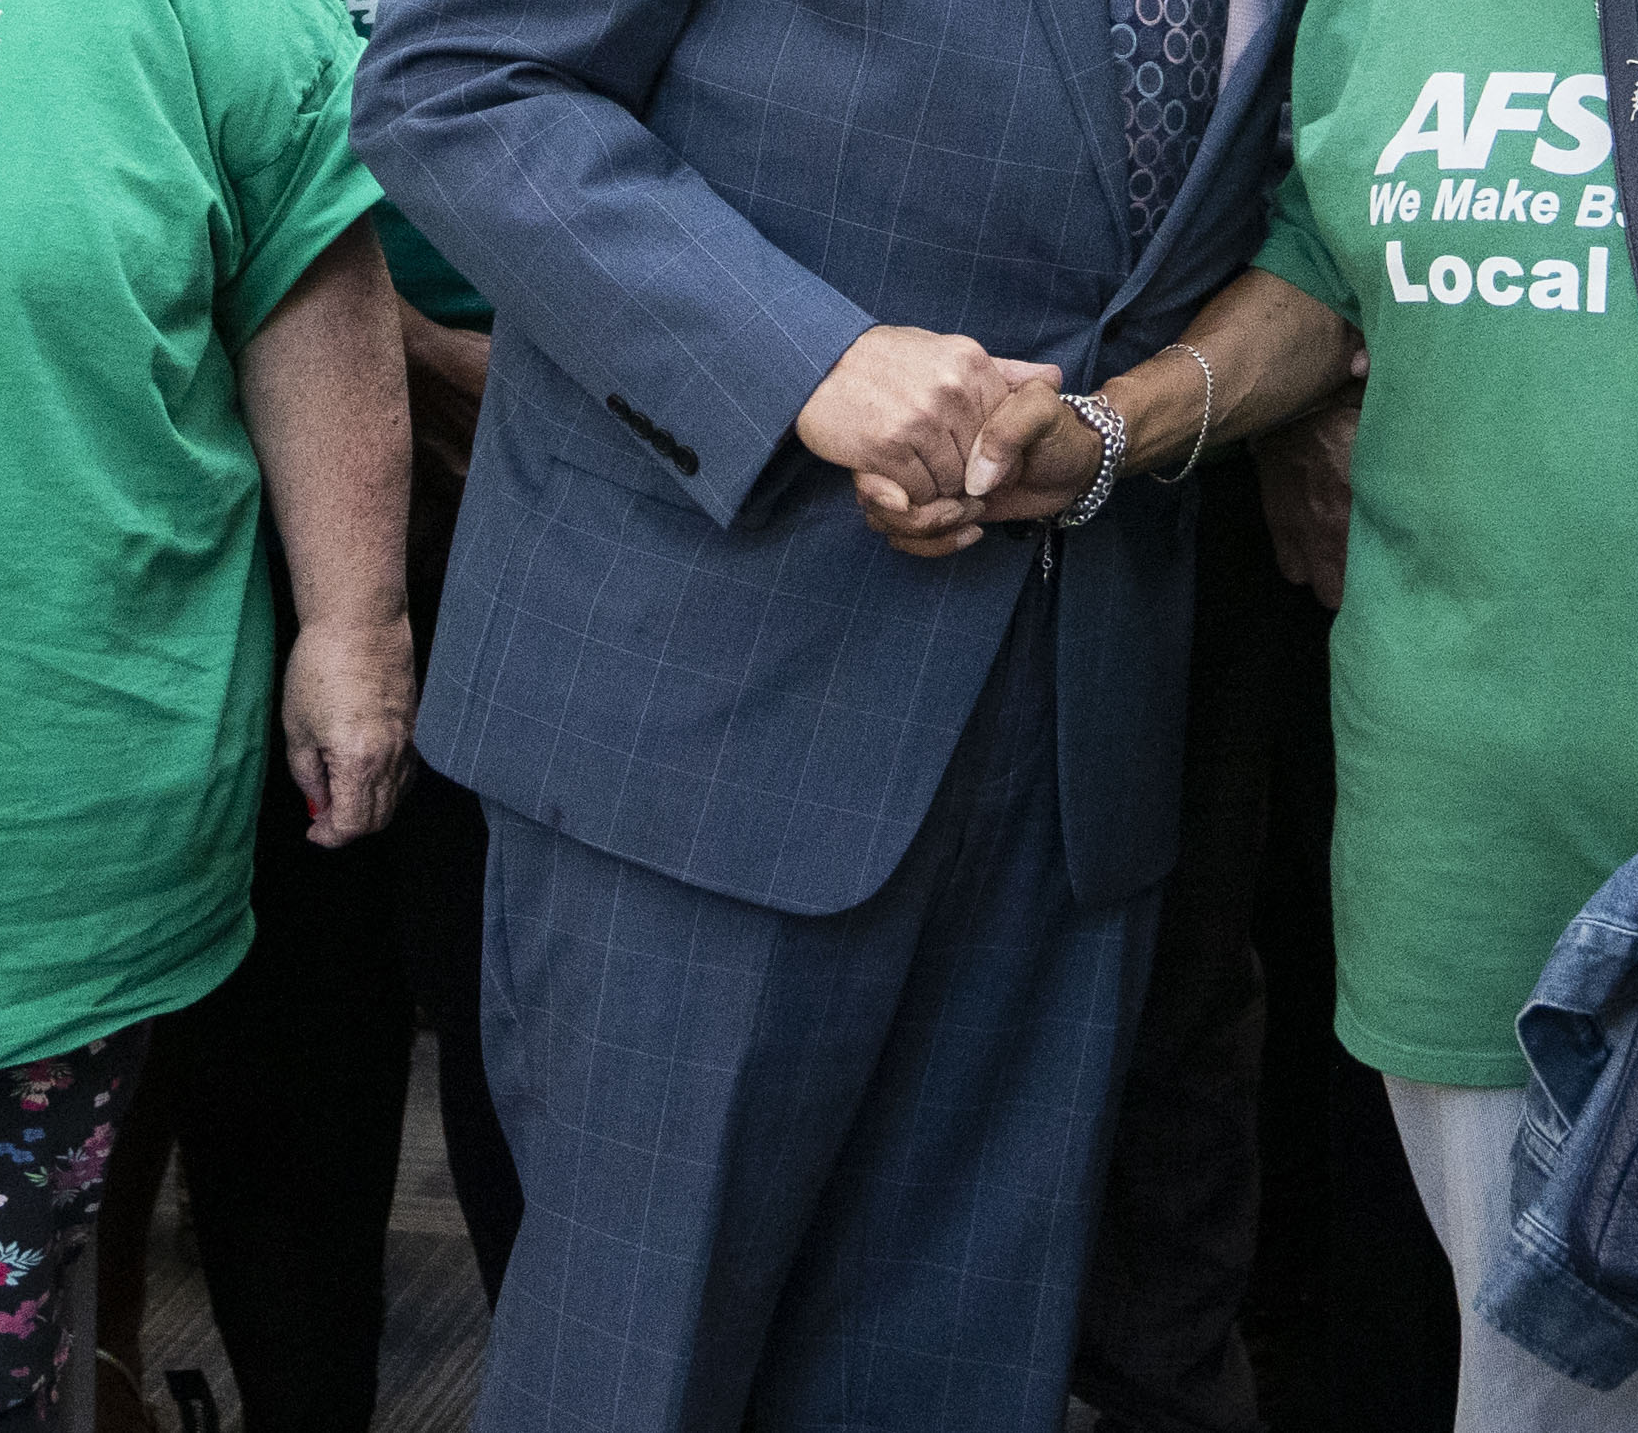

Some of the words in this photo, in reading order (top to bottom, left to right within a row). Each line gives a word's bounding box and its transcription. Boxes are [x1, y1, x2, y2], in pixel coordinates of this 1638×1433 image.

[1369, 181, 1420, 225] We
[1431, 178, 1559, 224] Make
[1386, 240, 1609, 313] Local
